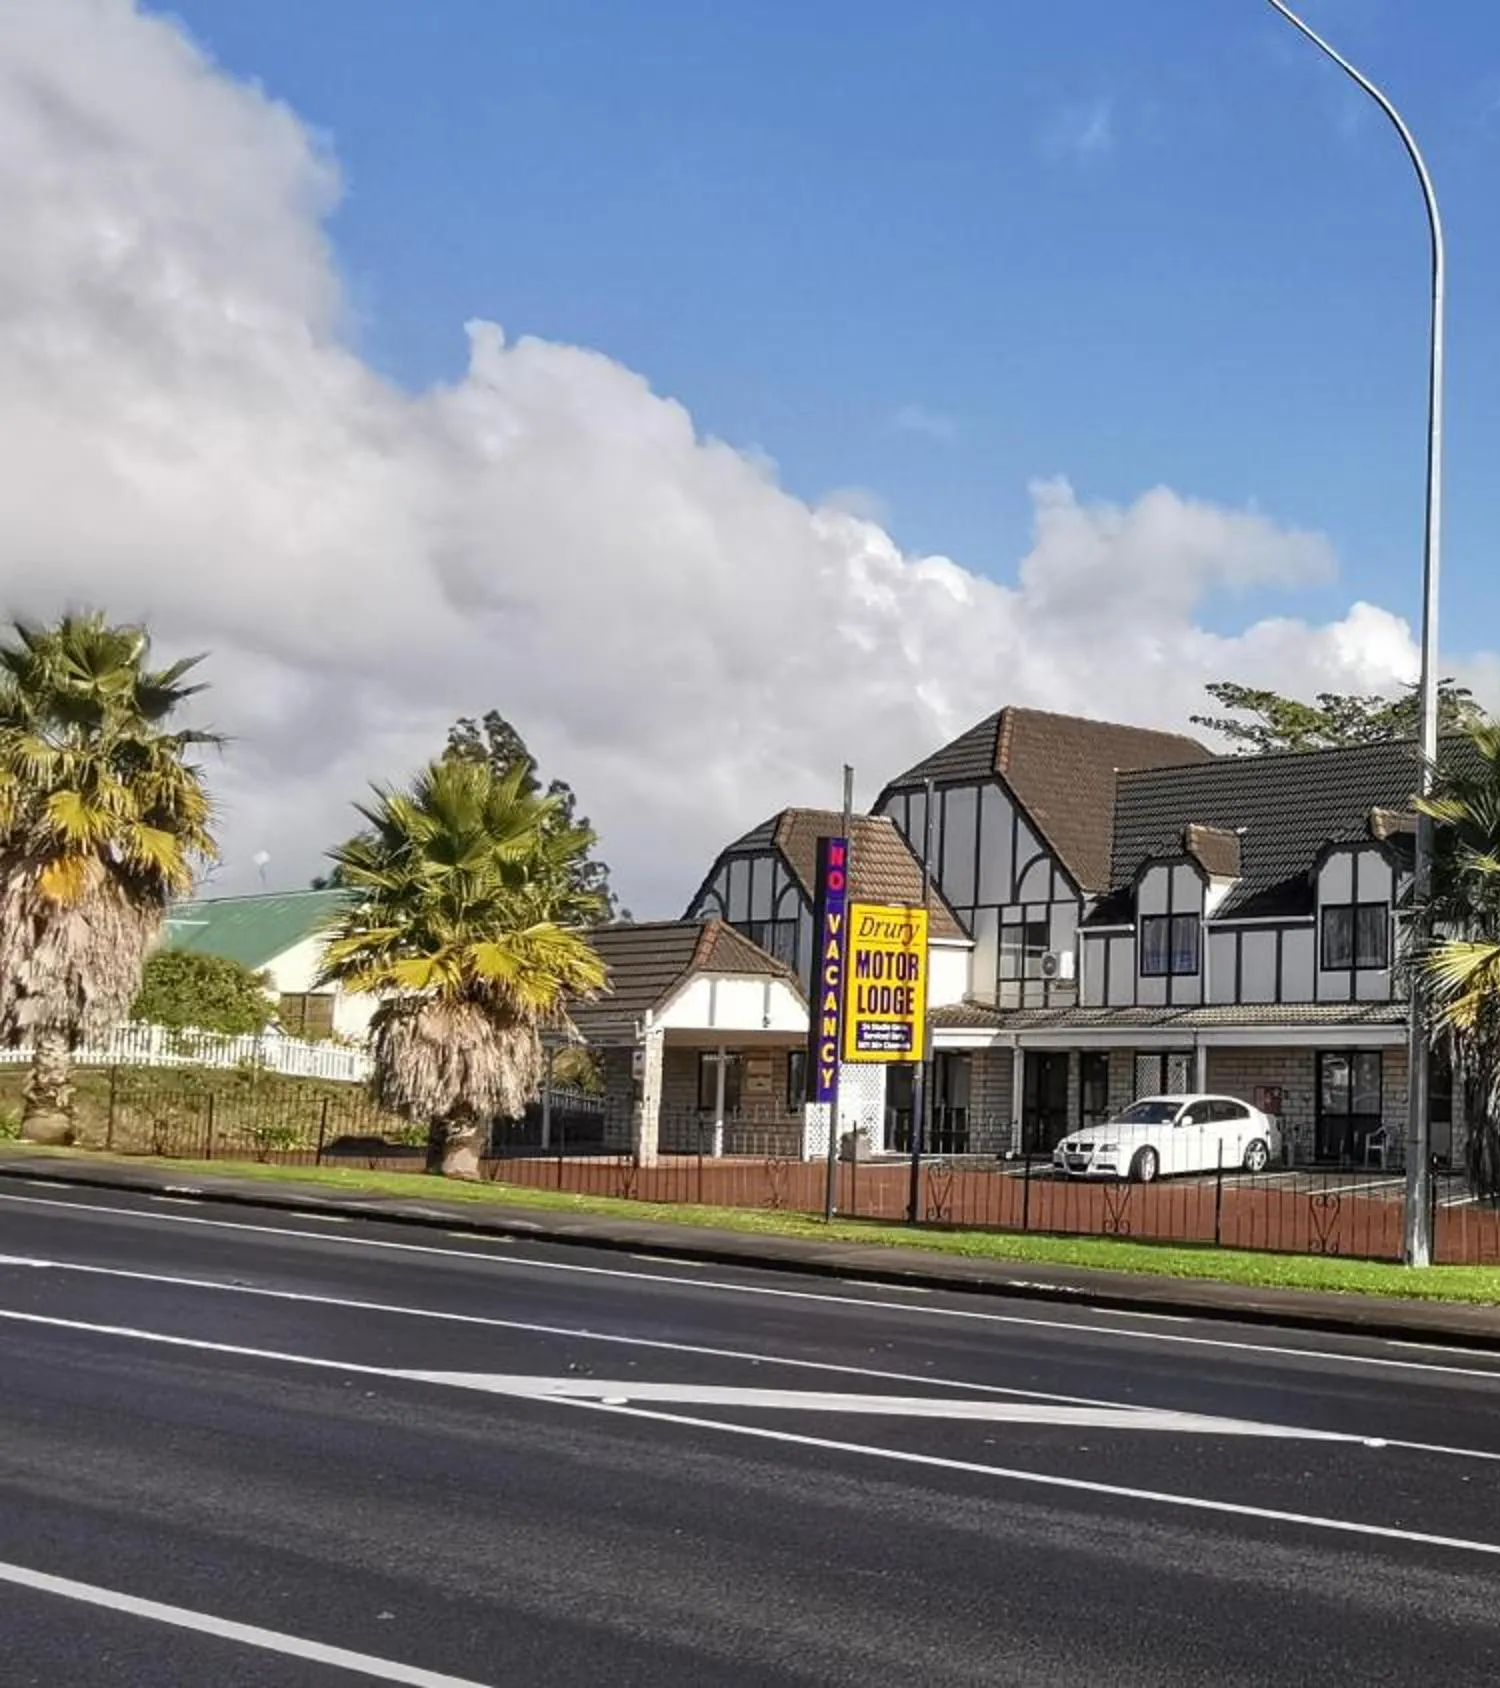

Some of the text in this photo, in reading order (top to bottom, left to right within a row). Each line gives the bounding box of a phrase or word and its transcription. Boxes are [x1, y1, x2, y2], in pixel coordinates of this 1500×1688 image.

[859, 916, 920, 946] Drury
[822, 847, 845, 1089] NO VACANCY
[856, 950, 918, 980] MOTOR
[857, 985, 914, 1014] LODGE
